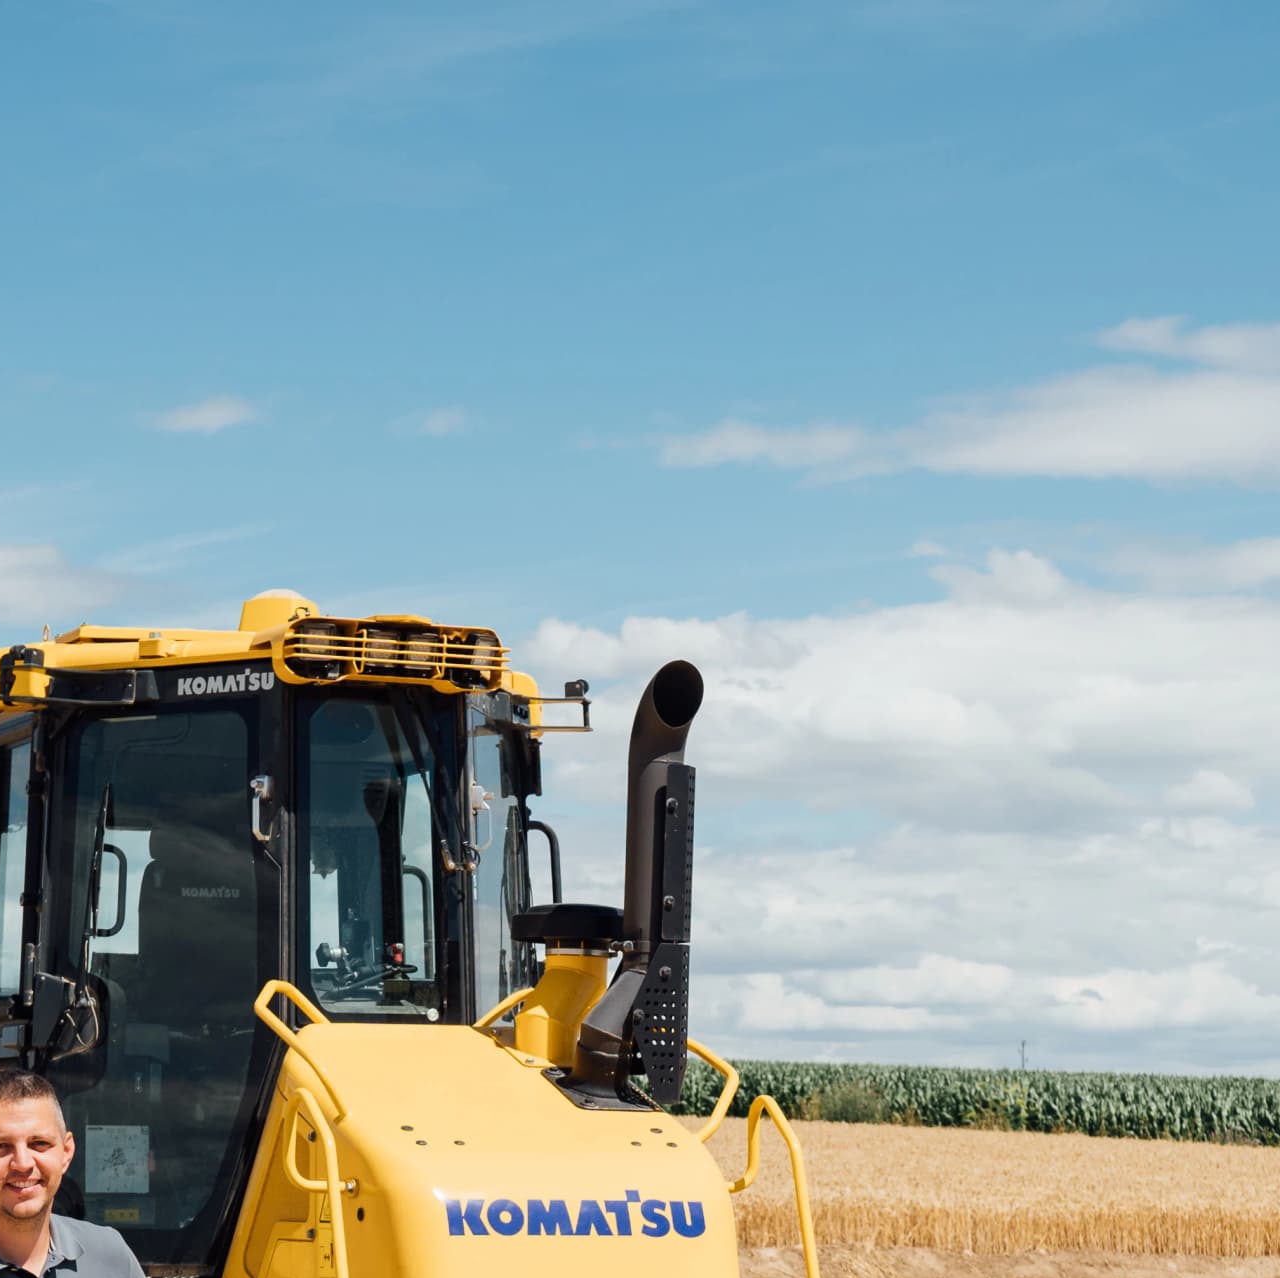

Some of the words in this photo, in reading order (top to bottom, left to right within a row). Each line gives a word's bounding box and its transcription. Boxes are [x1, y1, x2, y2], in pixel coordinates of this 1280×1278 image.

[177, 668, 275, 696] KOMATSU
[181, 886, 240, 898] KOMATSU
[445, 1190, 706, 1238] KOMATSU
